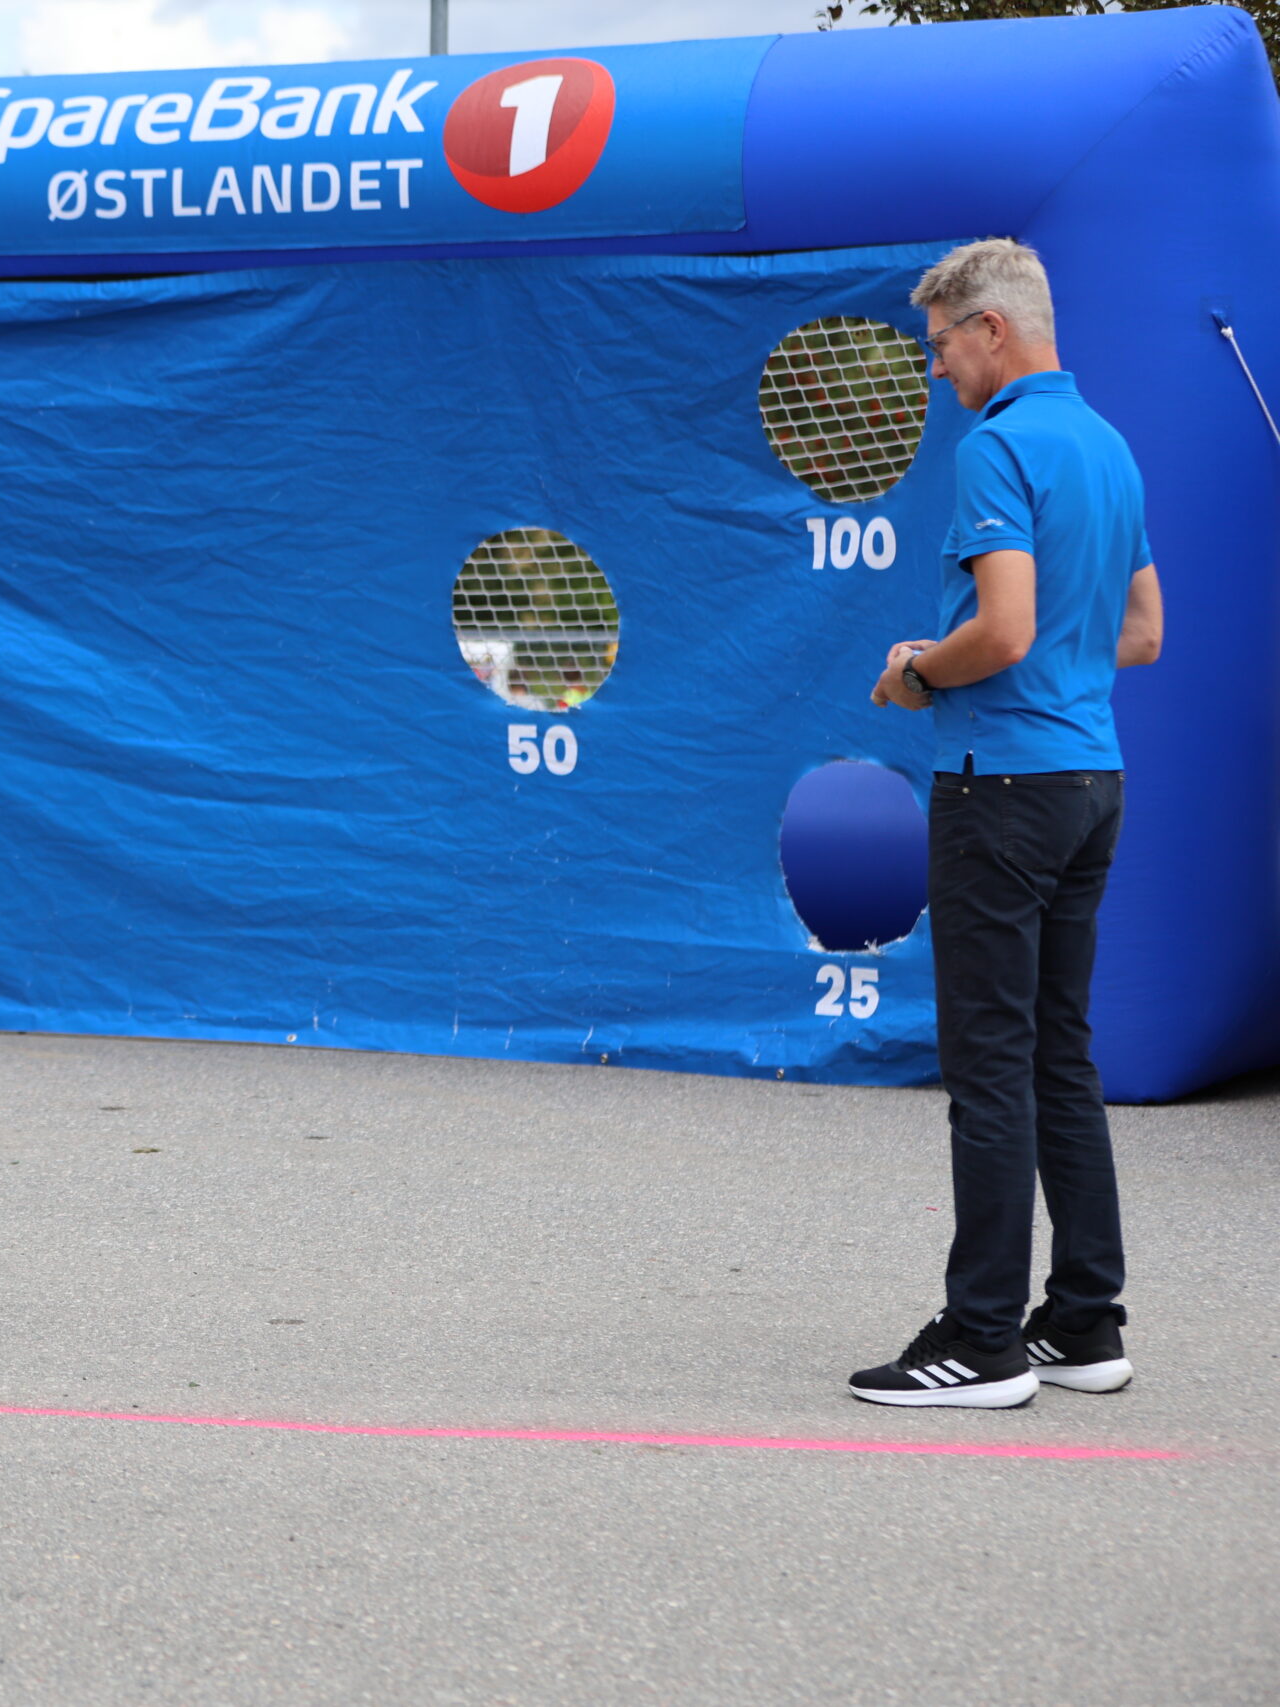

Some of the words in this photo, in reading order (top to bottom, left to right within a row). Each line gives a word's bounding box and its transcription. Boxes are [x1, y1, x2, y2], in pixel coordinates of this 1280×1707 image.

[500, 75, 563, 177] 1
[47, 159, 423, 222] ØSTLANDET
[806, 516, 897, 571] 100
[508, 724, 578, 776] 50
[814, 964, 880, 1019] 25
